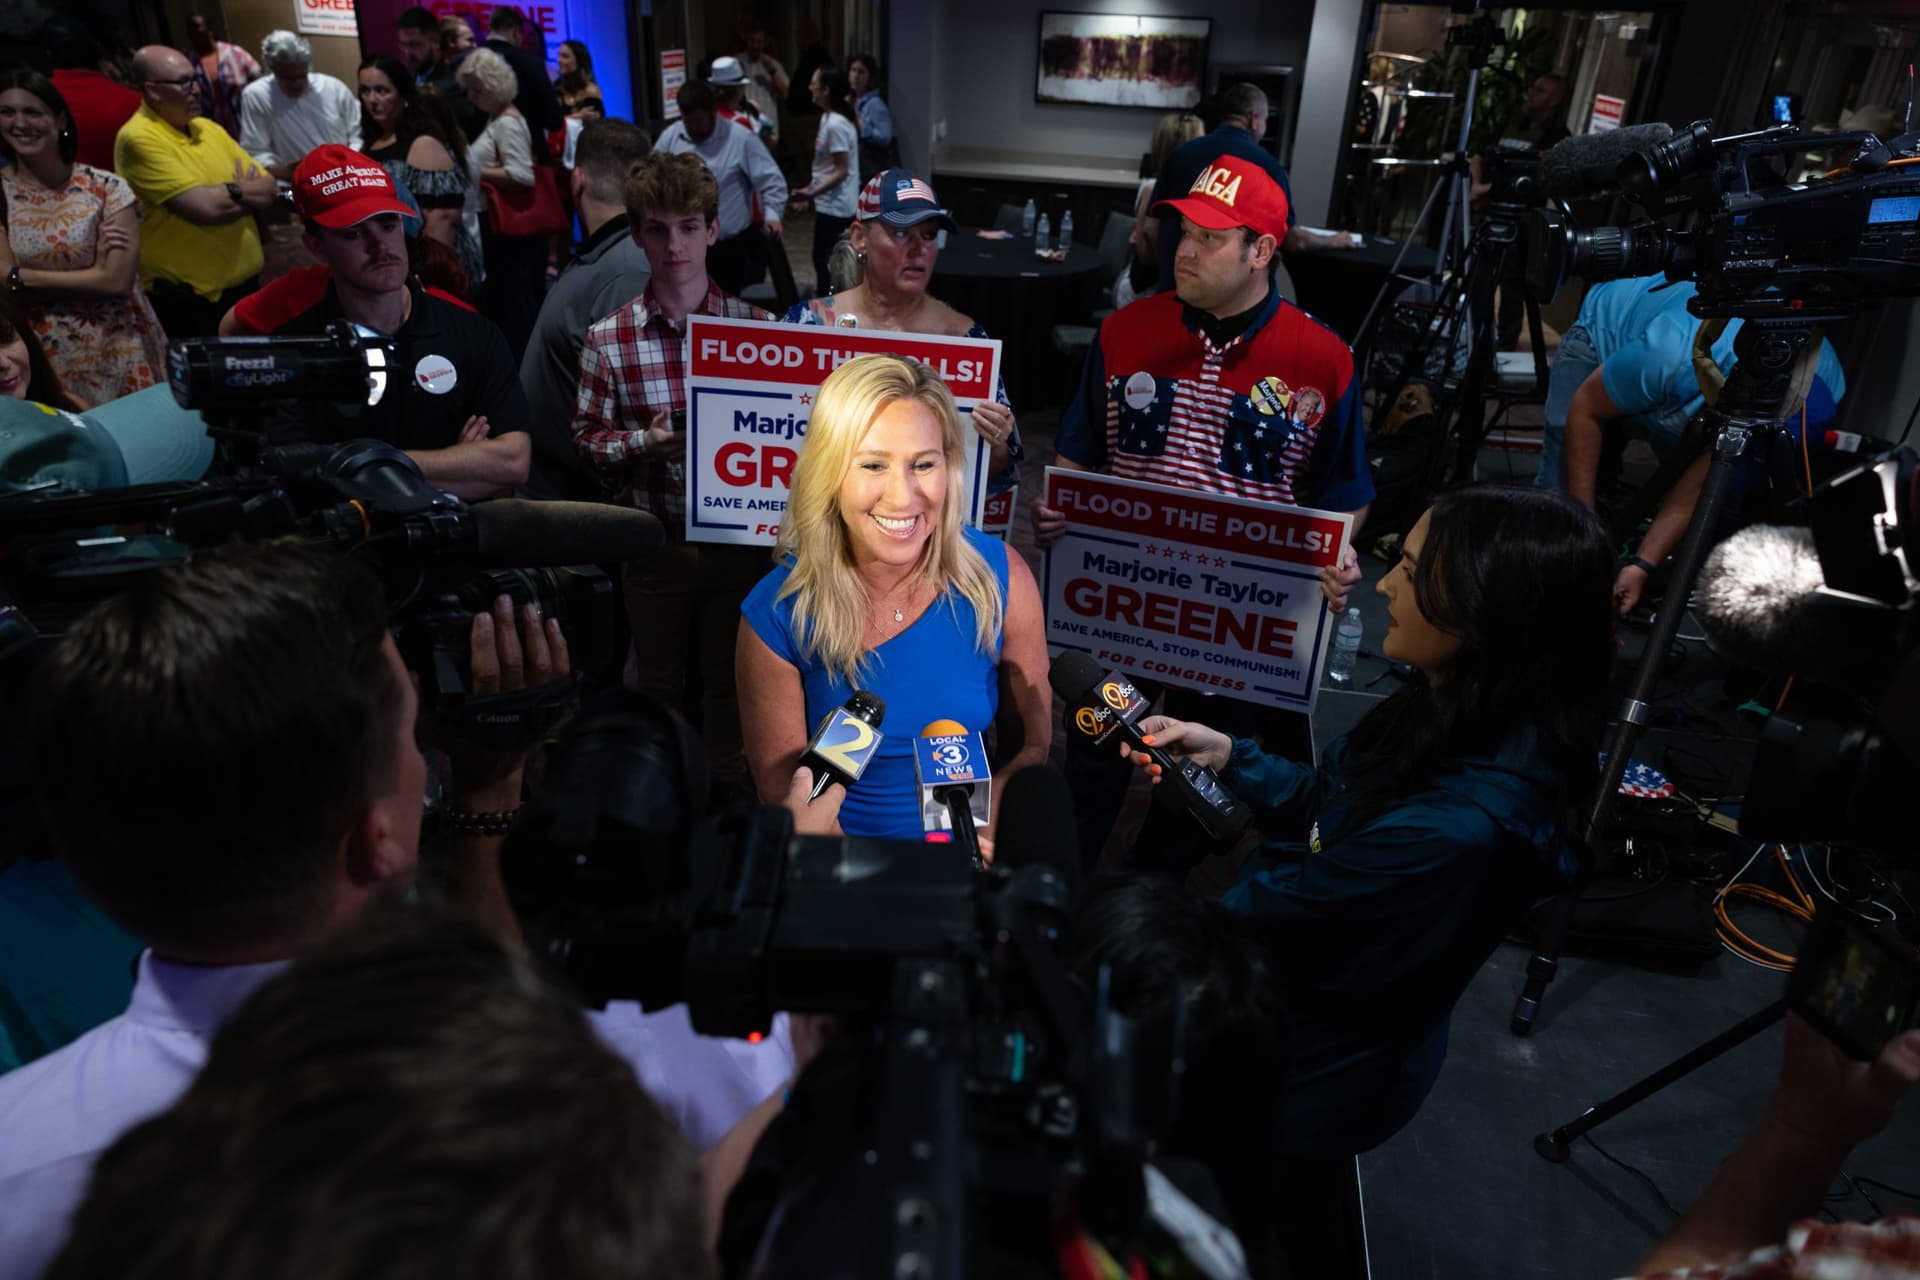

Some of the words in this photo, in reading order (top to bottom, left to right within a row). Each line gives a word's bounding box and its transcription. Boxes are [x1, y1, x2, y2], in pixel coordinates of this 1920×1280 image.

[310, 167, 343, 186] MAKE
[322, 177, 358, 195] GREAT
[1188, 165, 1242, 207] AGA
[225, 355, 275, 370] Frezzi
[701, 338, 804, 368] FLOOD
[813, 348, 869, 370] TH
[703, 496, 742, 509] SAVE
[1057, 488, 1152, 521] FLOOD
[1161, 506, 1218, 533] THE
[1225, 517, 1333, 553] POLLS!
[1083, 551, 1192, 590] Marjorie
[1201, 574, 1288, 607] Taylor
[1064, 578, 1298, 659] GREENE
[1052, 620, 1088, 635] SAVE
[1091, 628, 1160, 650] AMERICA,
[1162, 642, 1199, 658] STOP
[1203, 652, 1300, 681] COMMUNISM!
[1098, 650, 1136, 667] FOR
[1142, 659, 1246, 691] CONGRESS
[1103, 682, 1129, 710] 9
[1119, 684, 1134, 698] abc
[1076, 707, 1104, 736] 9
[1094, 707, 1111, 722] abc
[815, 718, 873, 777] 2
[930, 735, 966, 745] LOCAL
[943, 745, 962, 764] 3
[936, 765, 973, 776] NEWS
